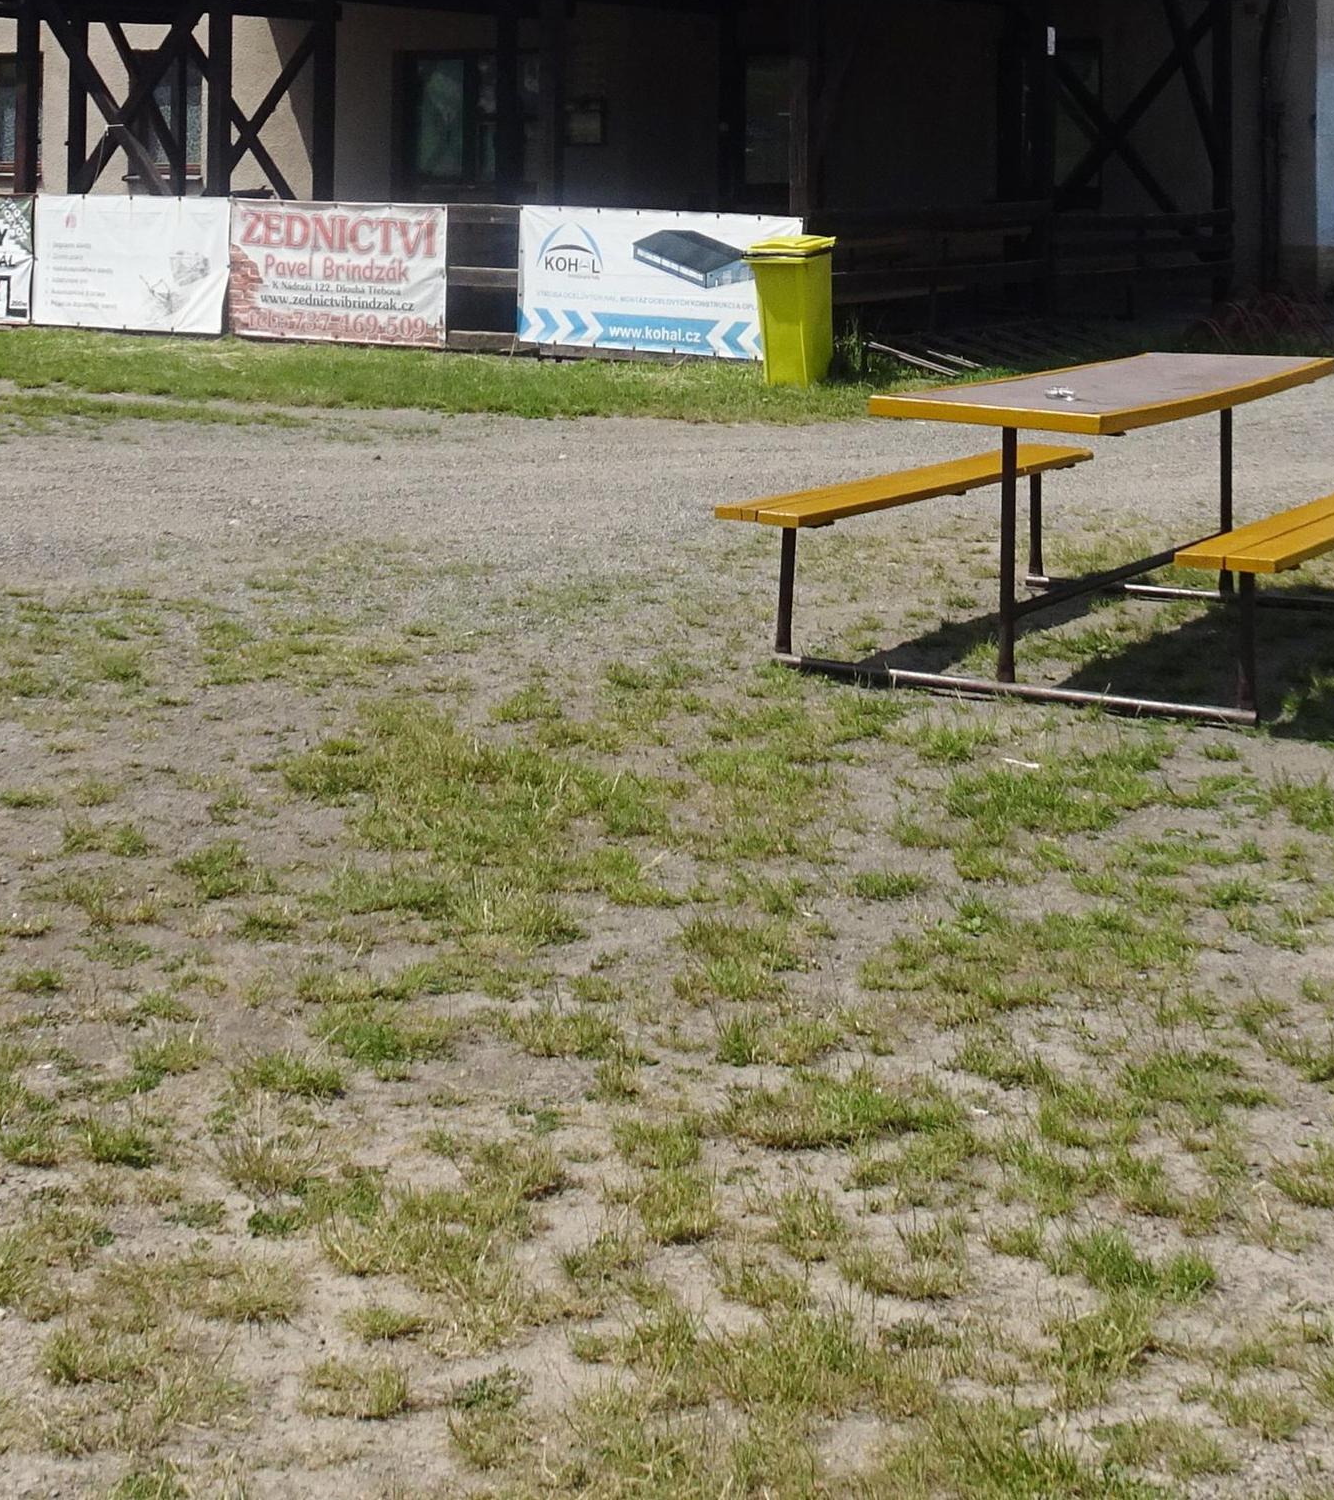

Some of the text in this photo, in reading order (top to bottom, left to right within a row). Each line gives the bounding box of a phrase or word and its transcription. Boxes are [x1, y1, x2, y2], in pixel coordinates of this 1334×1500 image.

[240, 209, 439, 258] ZEDNICTVÍ
[265, 253, 411, 285] Pavel Brindzák
[260, 293, 416, 312] www.zednictvibrindzak.cz
[609, 325, 701, 343] www.kohal.cz
